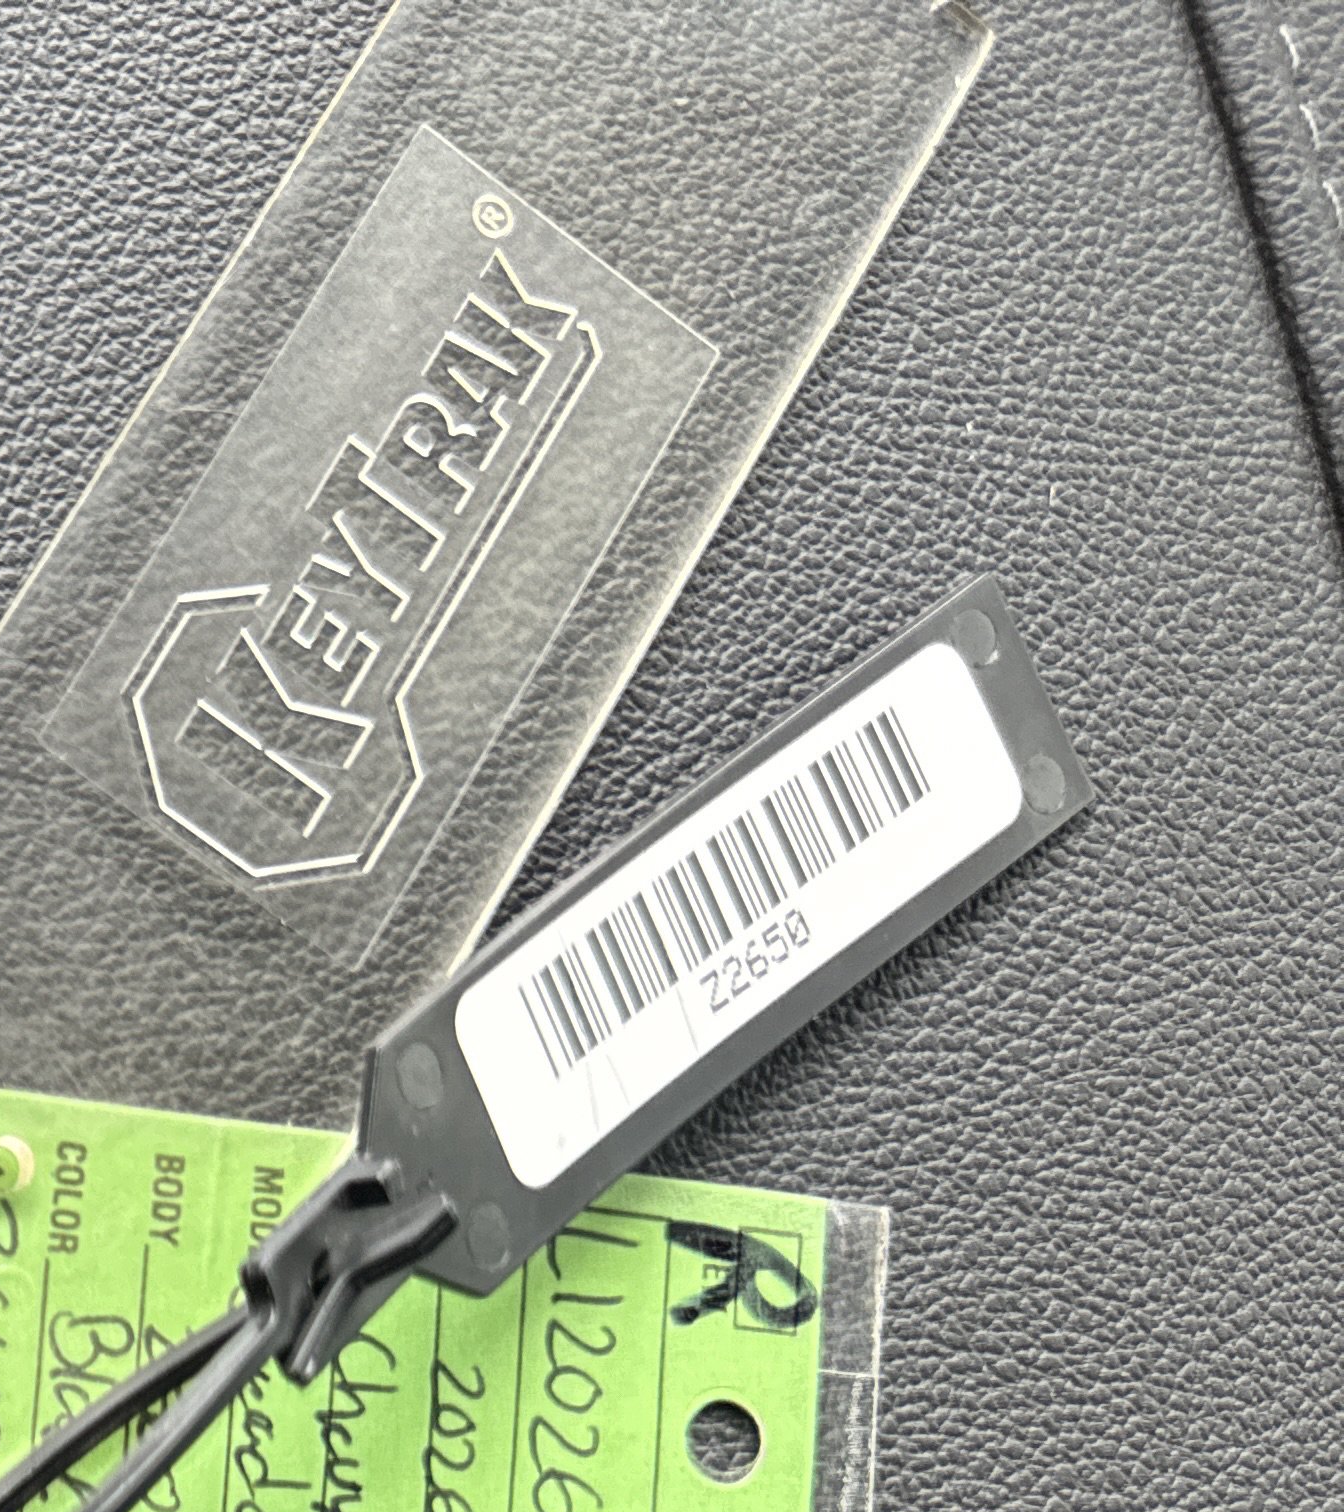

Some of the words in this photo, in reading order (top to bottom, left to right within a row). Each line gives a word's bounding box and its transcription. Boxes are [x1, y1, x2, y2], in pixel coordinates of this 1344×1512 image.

[698, 907, 812, 1014] Z2650
[46, 1140, 88, 1255] COLOR
[148, 1151, 186, 1248] BODY
[664, 1219, 818, 1328] R
